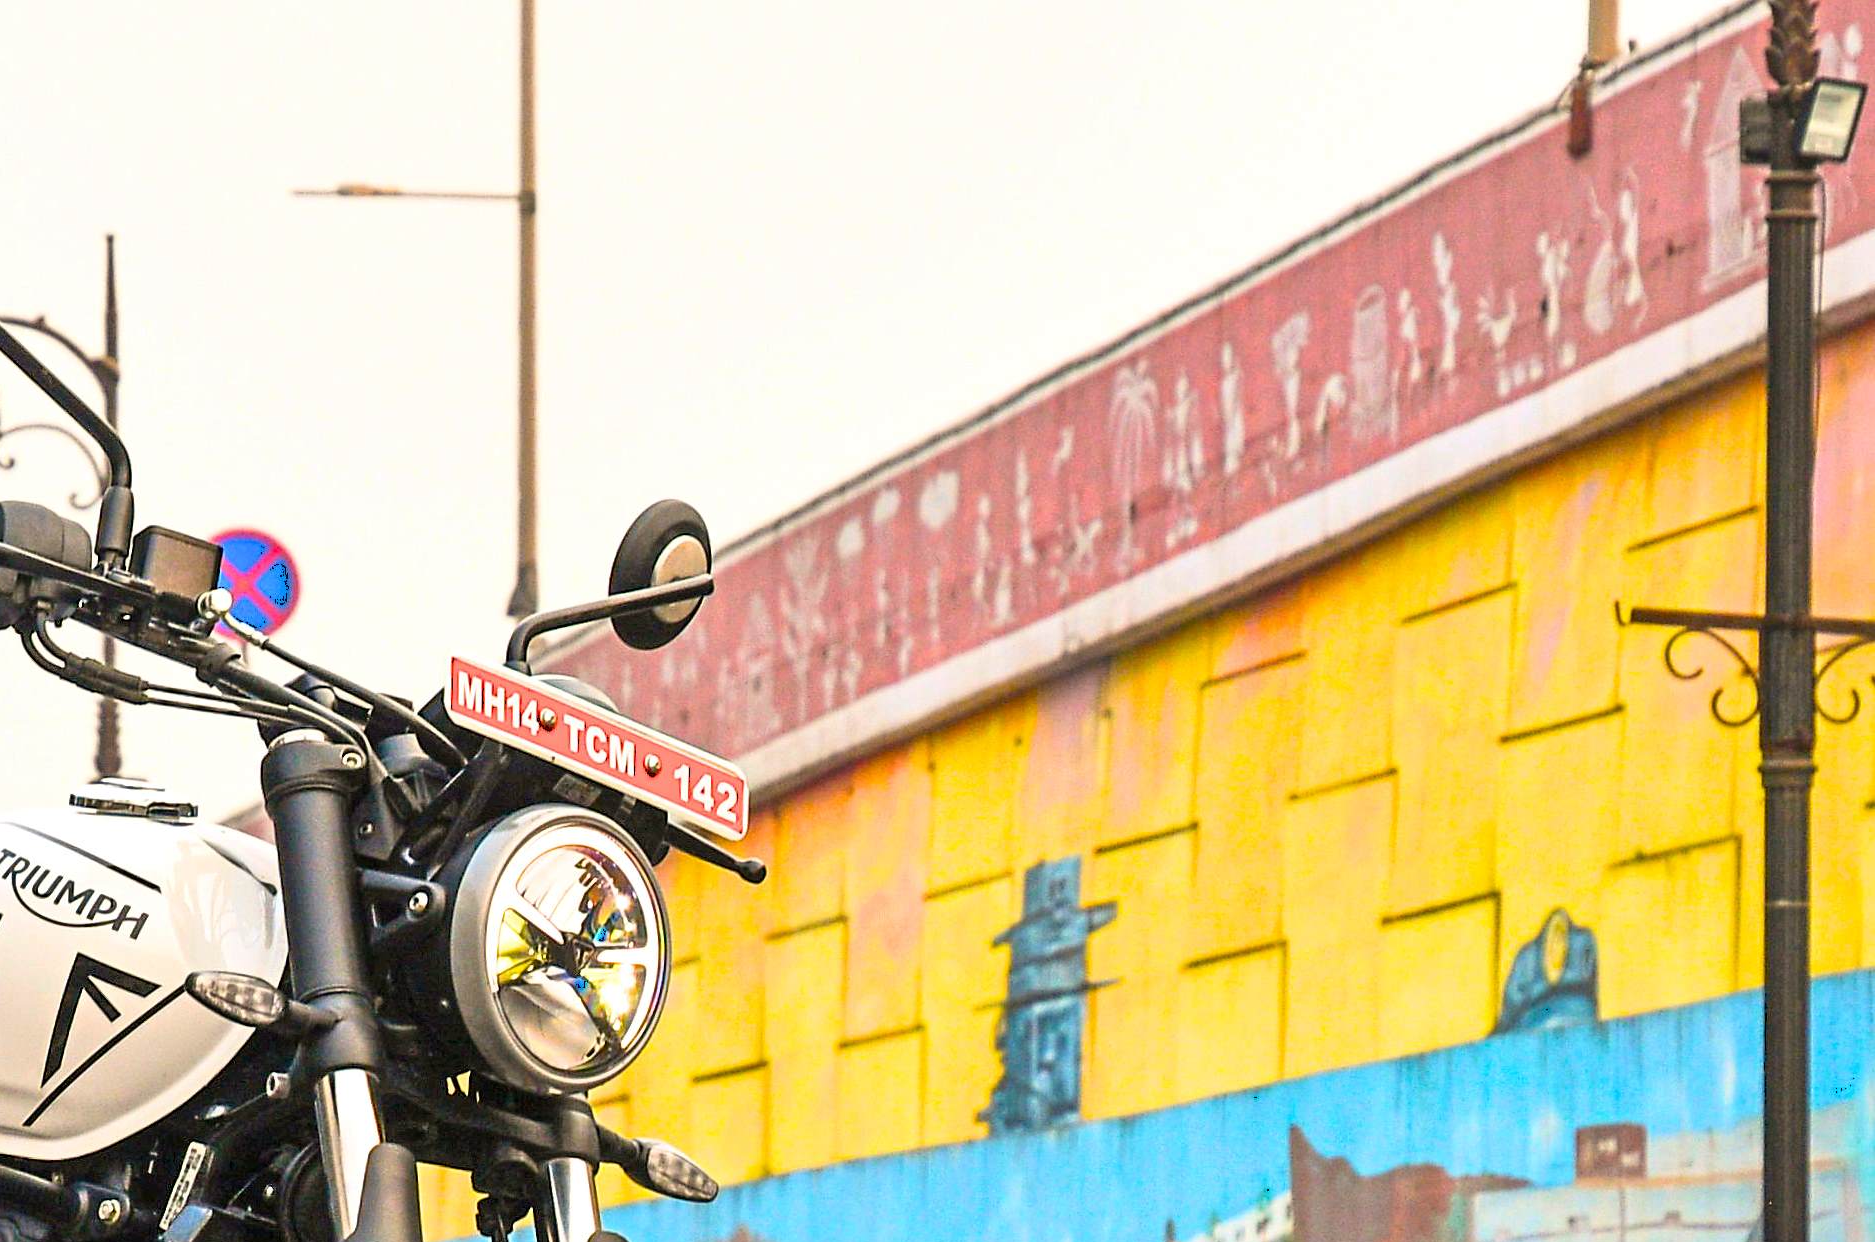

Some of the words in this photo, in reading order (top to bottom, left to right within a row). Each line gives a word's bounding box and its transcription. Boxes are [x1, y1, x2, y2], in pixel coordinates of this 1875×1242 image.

[457, 671, 541, 736] MH14
[564, 714, 636, 777] TCM
[674, 764, 738, 823] 142
